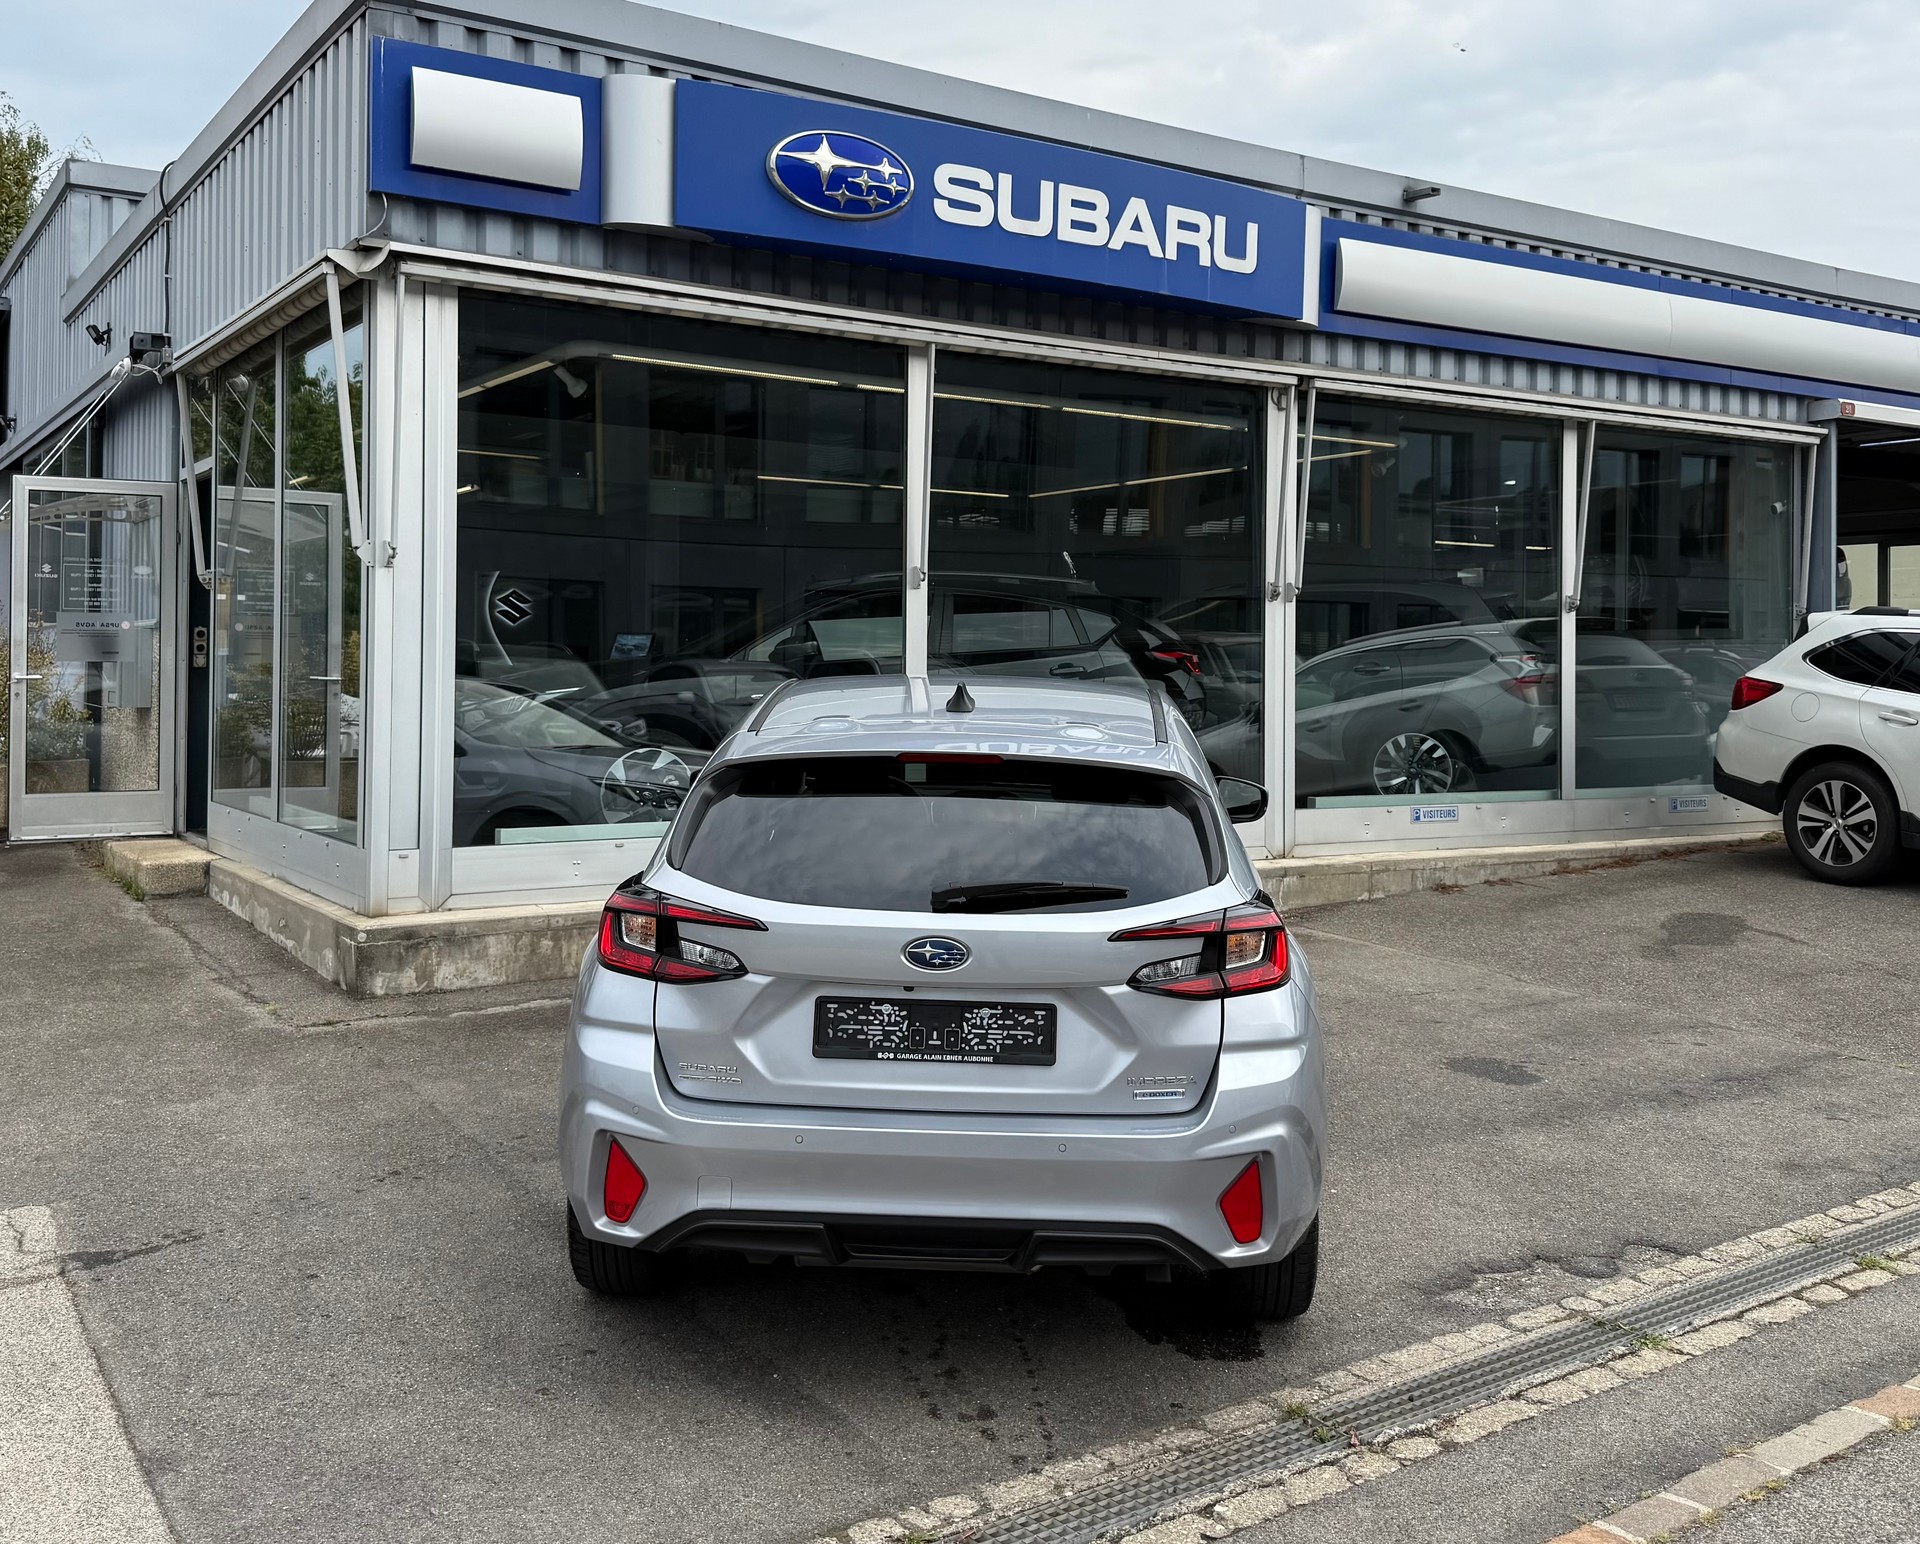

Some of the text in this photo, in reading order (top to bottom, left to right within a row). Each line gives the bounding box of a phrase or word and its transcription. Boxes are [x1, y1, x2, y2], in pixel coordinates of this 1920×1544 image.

[932, 162, 1259, 274] SUBARU
[1679, 799, 1707, 808] VISITEURS
[1423, 809, 1457, 819] VISITEURS
[896, 1052, 922, 1060] GARAGE
[923, 1053, 942, 1061] ALAIN
[679, 1062, 737, 1074] SUBARU
[1127, 1075, 1197, 1087] IMPREZA
